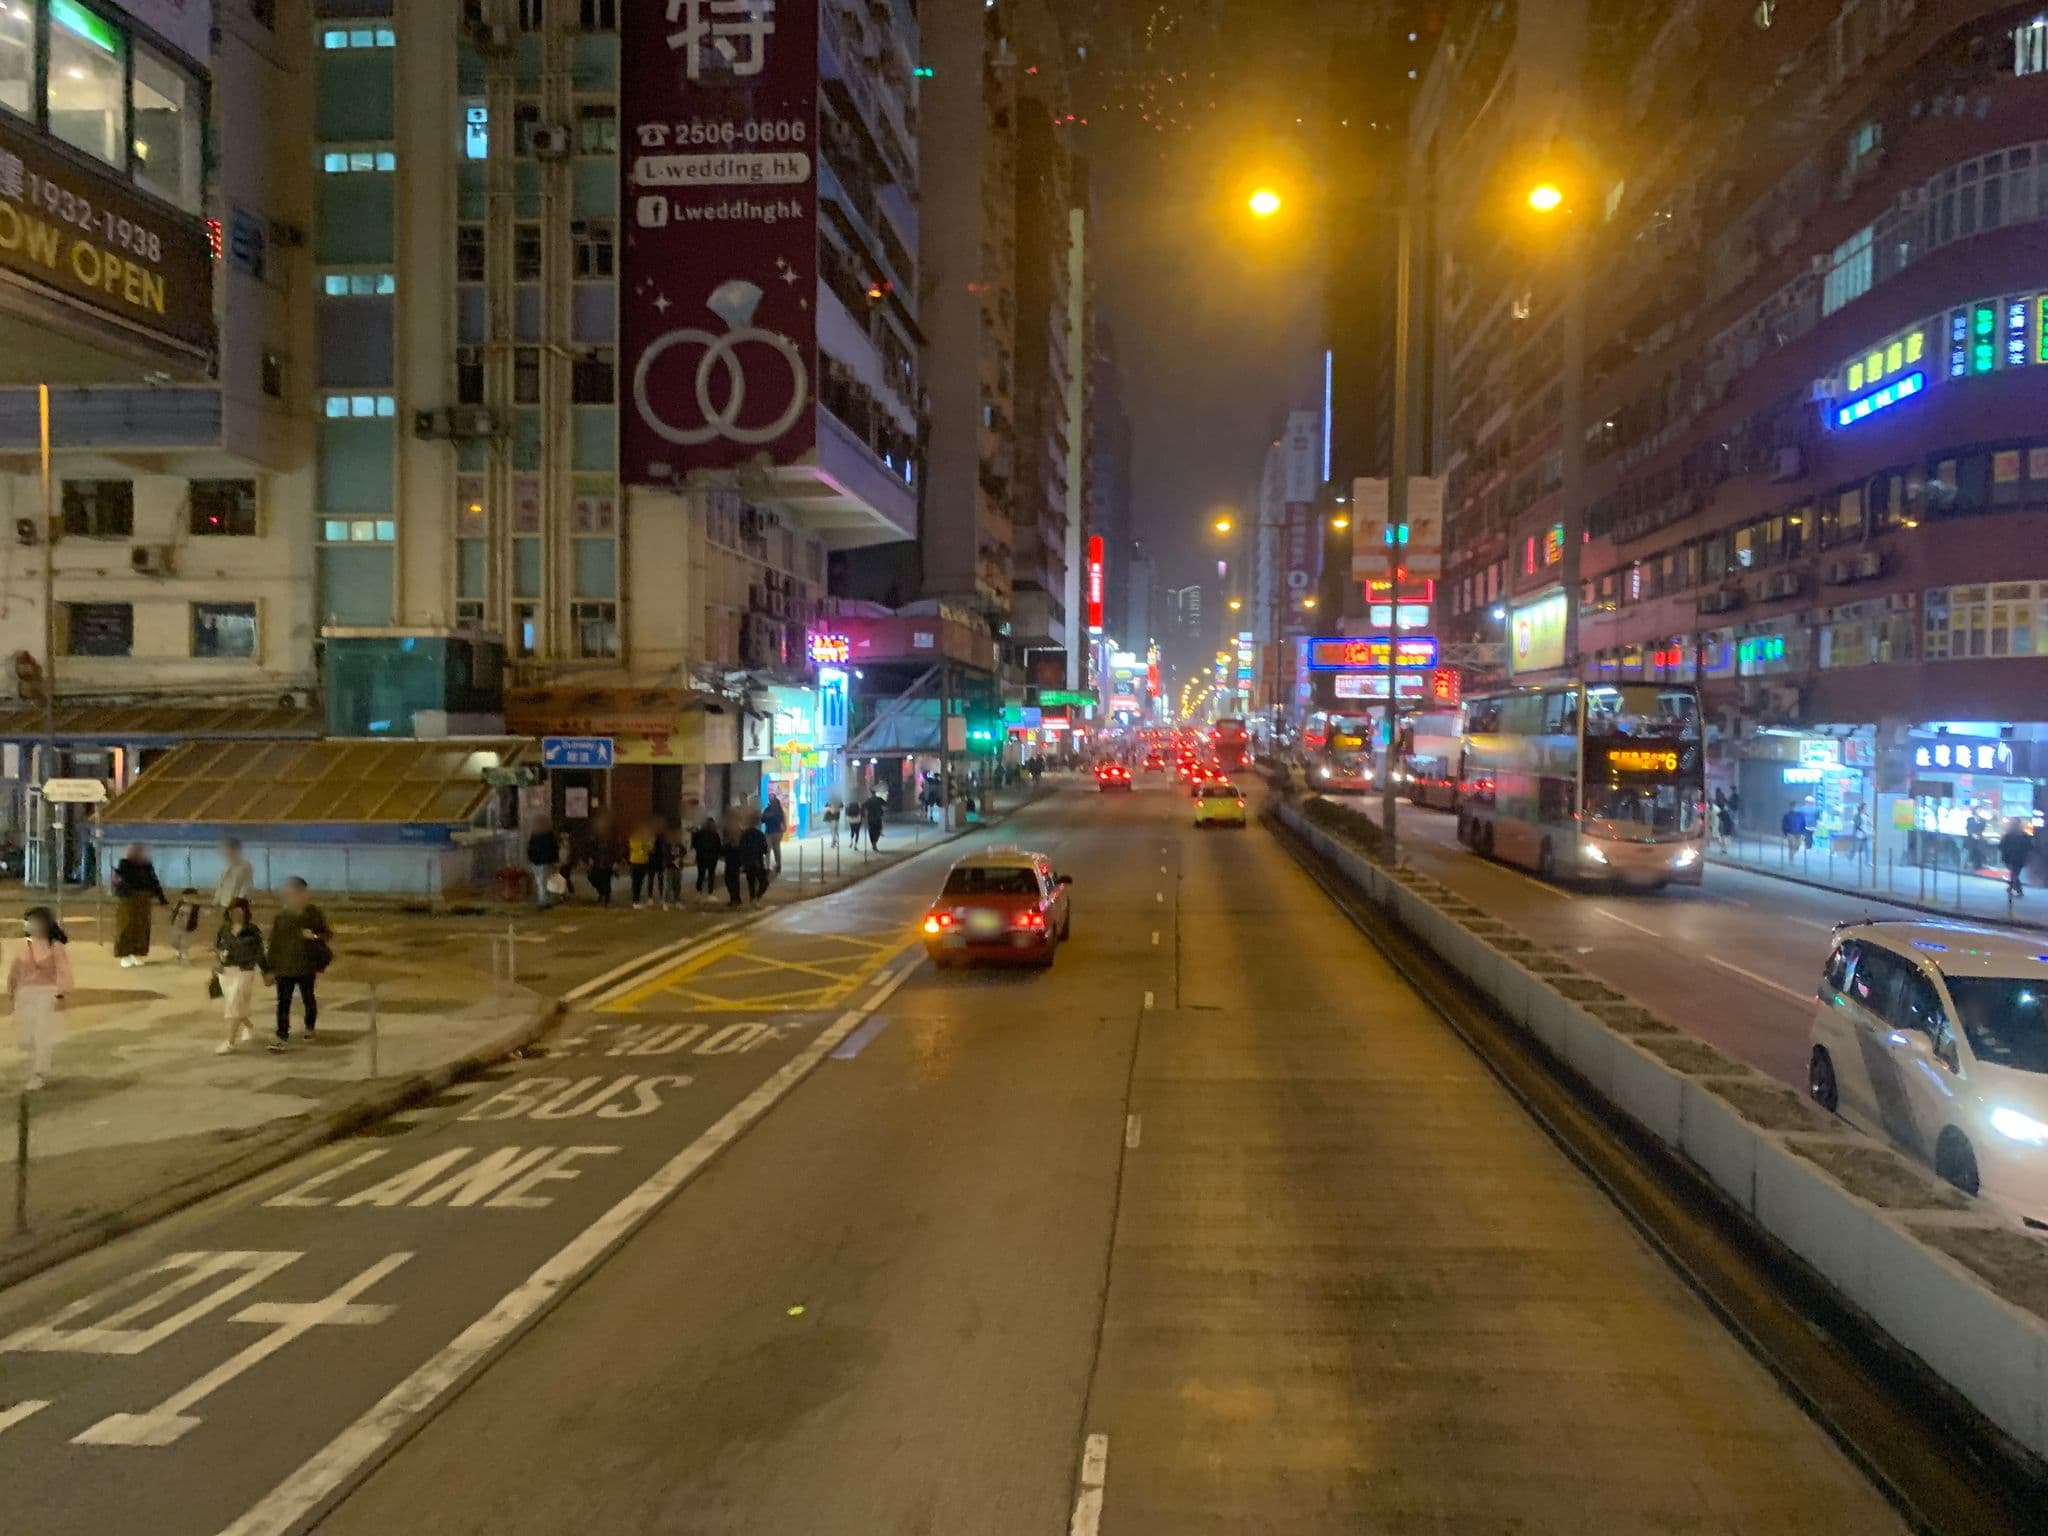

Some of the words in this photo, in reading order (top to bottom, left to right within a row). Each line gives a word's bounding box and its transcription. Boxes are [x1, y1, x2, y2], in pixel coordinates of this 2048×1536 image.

[675, 121, 806, 145] 2506-0606
[72, 240, 166, 315] OPEN
[1665, 753, 1677, 770] 6
[456, 1073, 694, 1122] BUS
[262, 1146, 624, 1208] LANE
